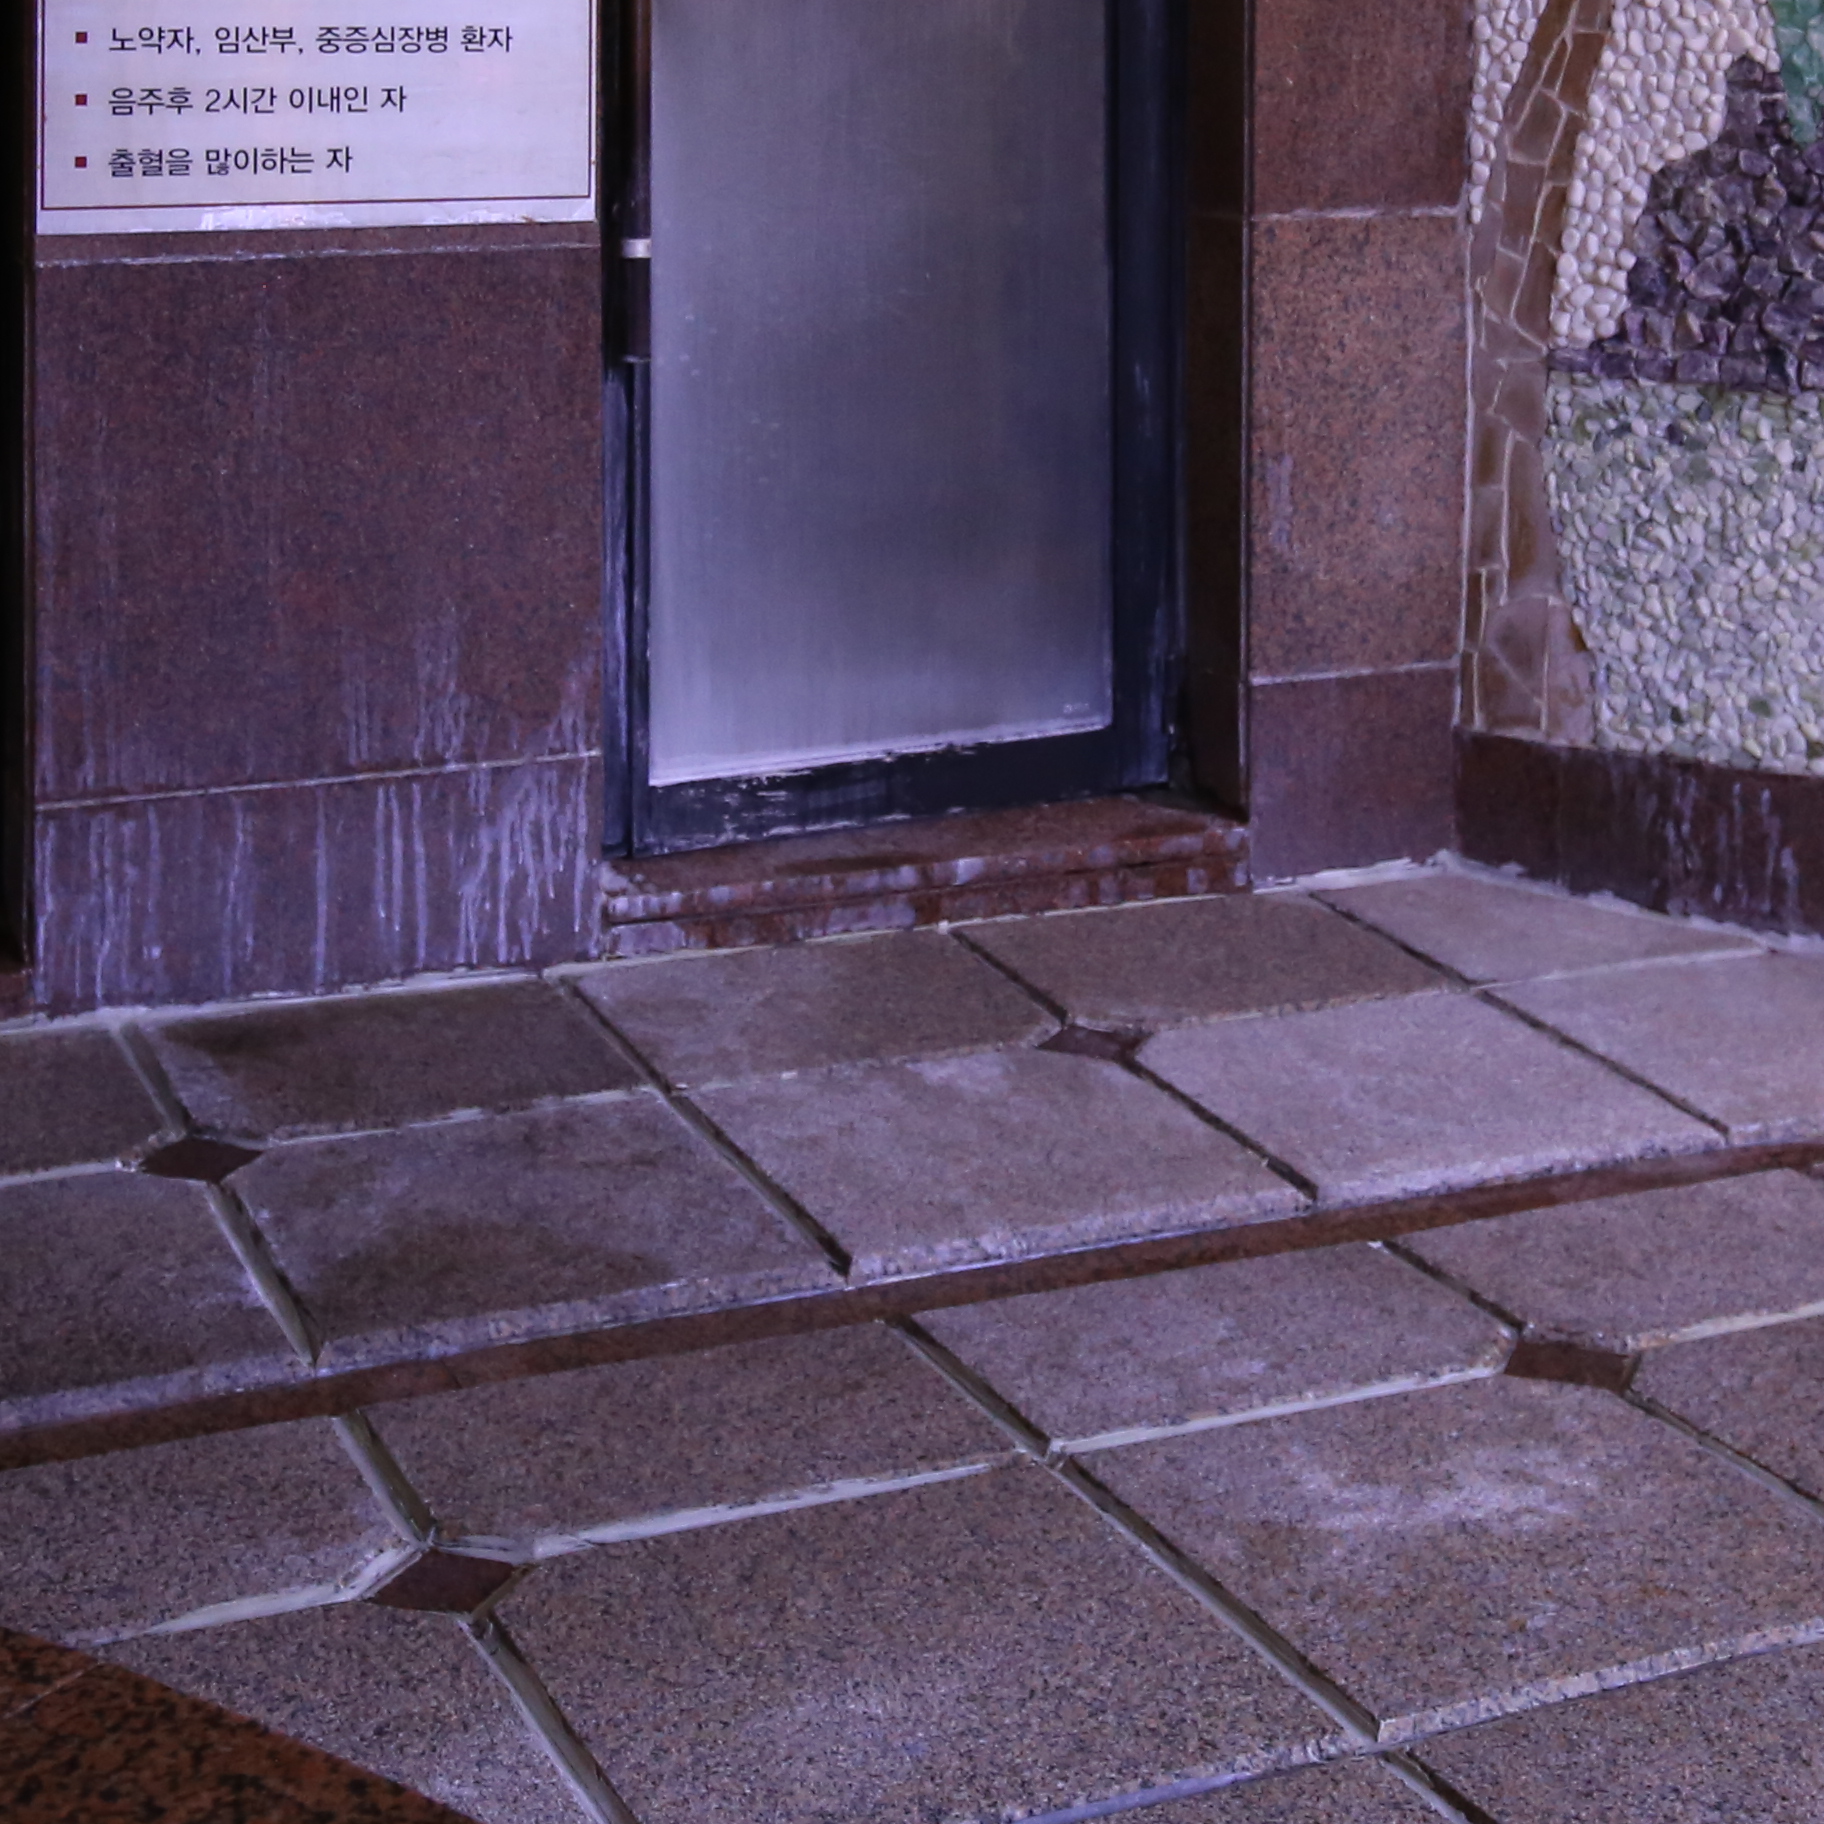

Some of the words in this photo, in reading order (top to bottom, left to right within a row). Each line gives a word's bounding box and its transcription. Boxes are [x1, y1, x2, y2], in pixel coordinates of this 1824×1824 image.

[109, 26, 201, 55] 노약자,
[215, 26, 303, 55] 임산부,
[316, 26, 449, 55] 중증심장병
[460, 25, 512, 54] 환자
[108, 87, 193, 115] 음주후
[205, 87, 277, 114] 2시간
[289, 86, 369, 113] 이내인
[380, 85, 408, 113] 자
[108, 148, 193, 177] 출혈을
[205, 147, 315, 175] 많이하는
[326, 146, 353, 174] 자
